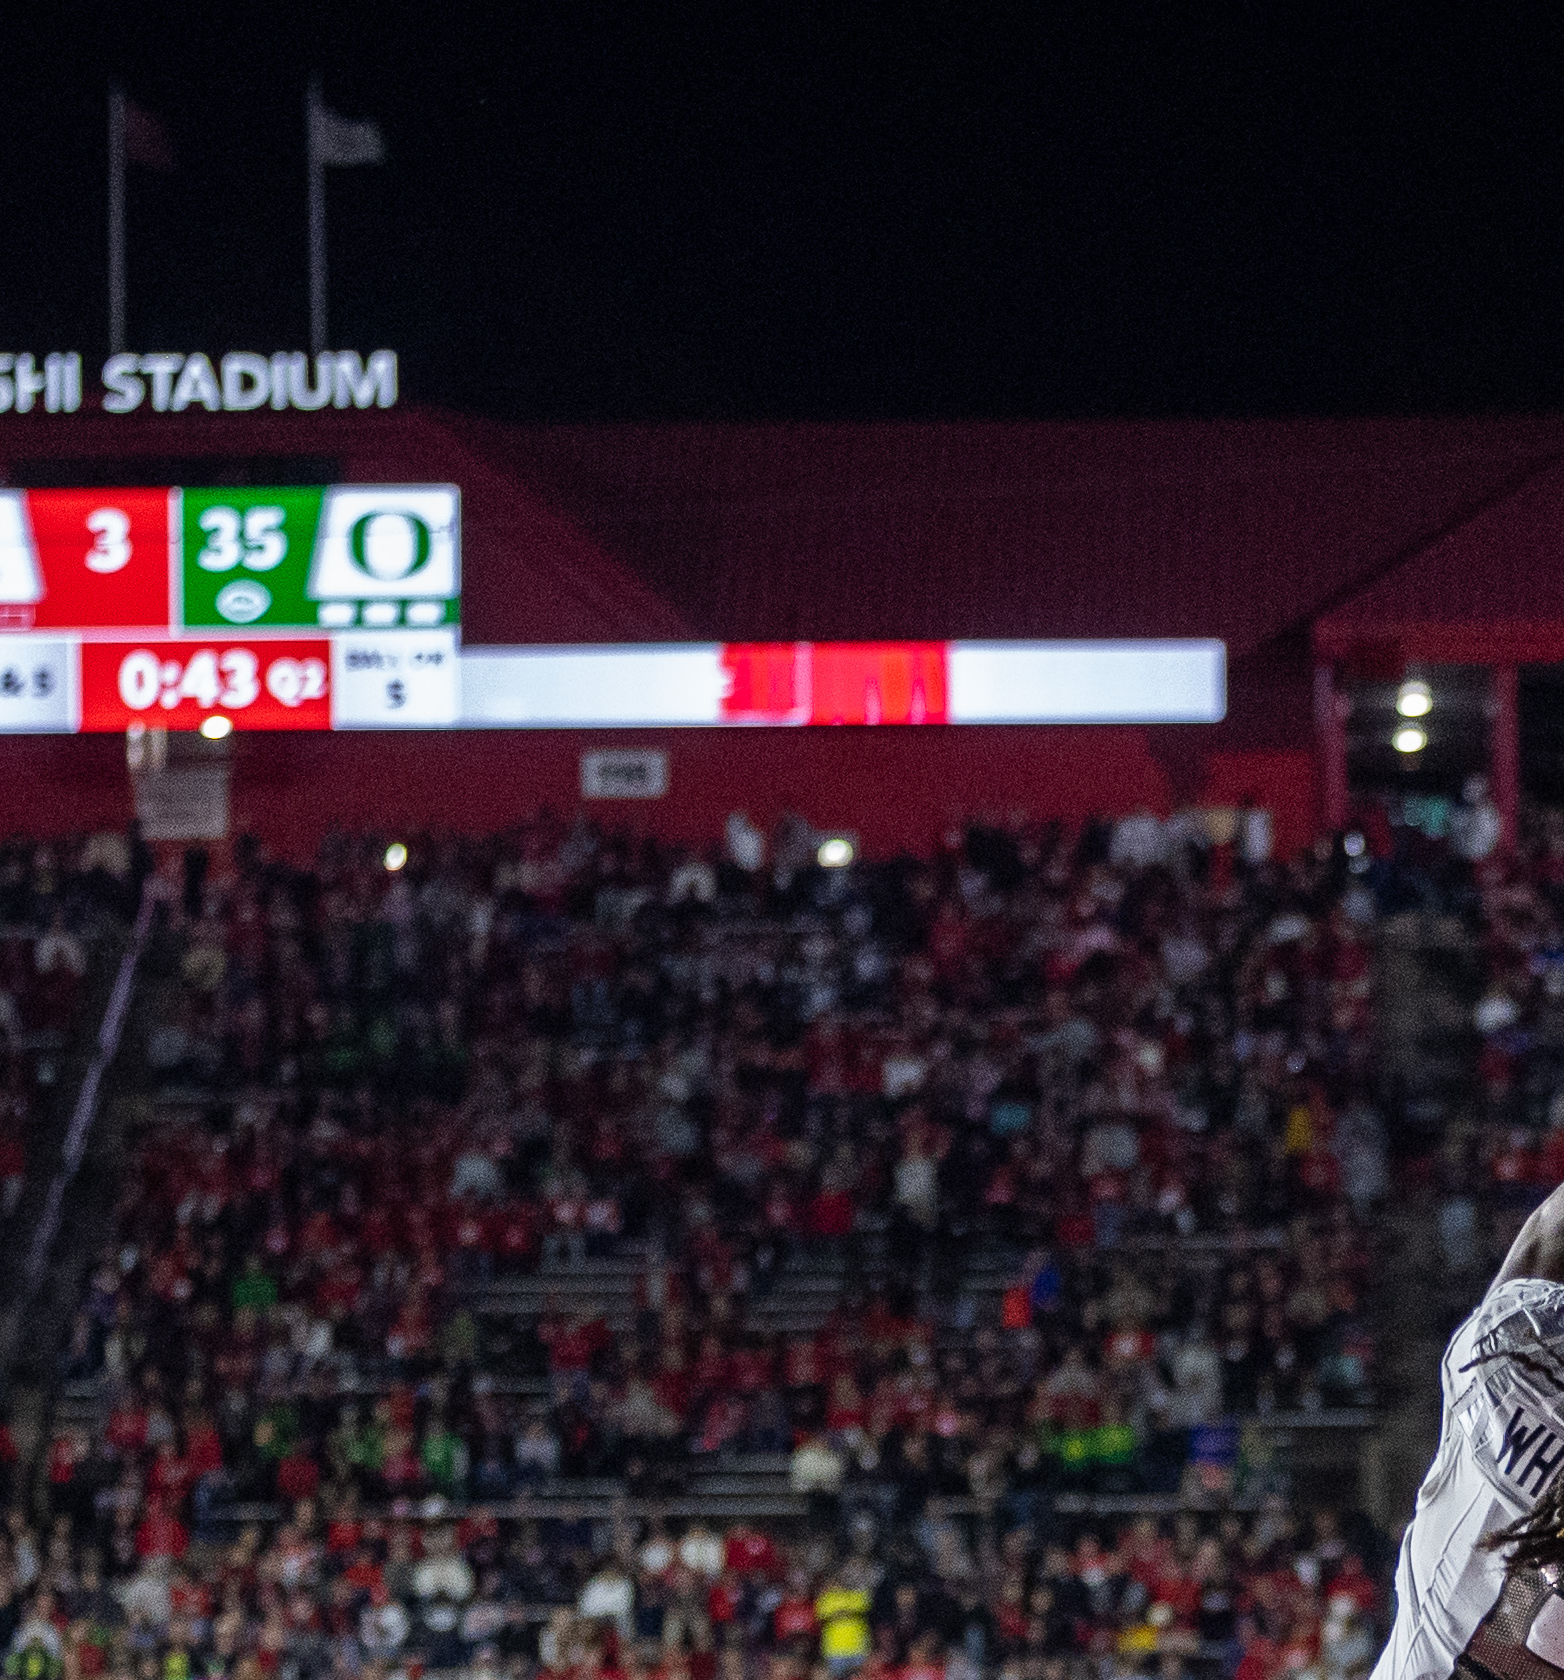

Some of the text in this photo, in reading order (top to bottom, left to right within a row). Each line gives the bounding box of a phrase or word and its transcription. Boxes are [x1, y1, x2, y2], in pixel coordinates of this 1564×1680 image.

[101, 349, 398, 414] STADIUM
[83, 506, 133, 574] 3
[195, 505, 289, 573] 35
[346, 510, 434, 582] O
[117, 647, 260, 711] 0:43
